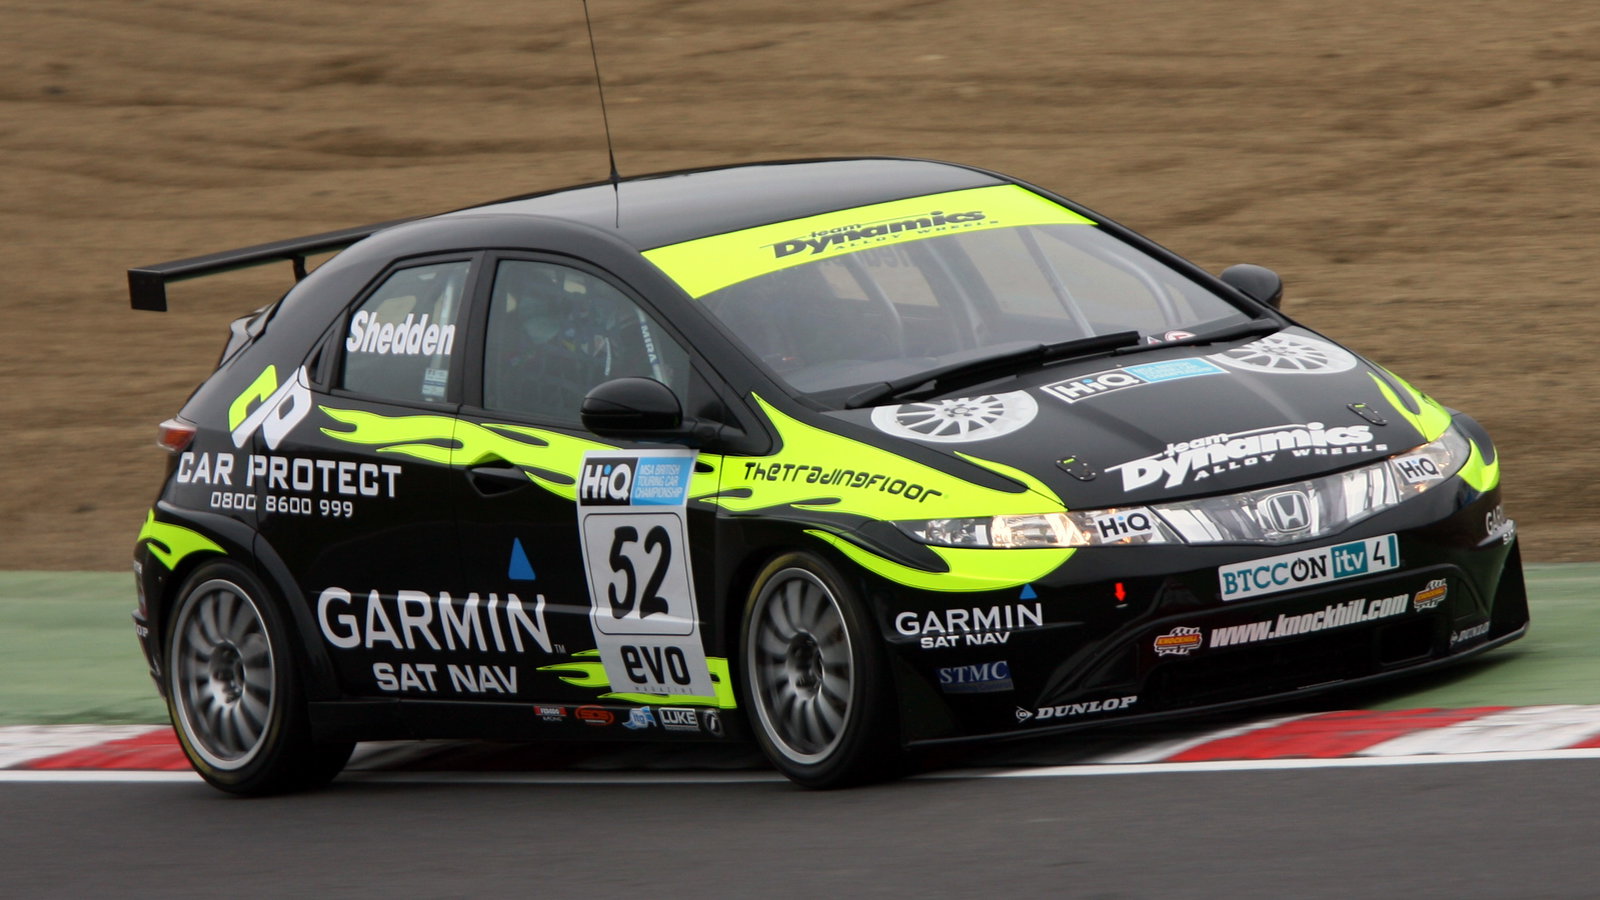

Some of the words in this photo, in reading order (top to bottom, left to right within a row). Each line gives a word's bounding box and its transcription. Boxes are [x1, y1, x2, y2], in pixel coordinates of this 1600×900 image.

[773, 210, 987, 258] Dynamics
[809, 223, 862, 239] team
[835, 235, 902, 250] ALLOY
[346, 309, 456, 356] Shedden
[1054, 373, 1140, 398] HiQ
[1121, 422, 1374, 492] Dynamics
[1164, 433, 1229, 457] team
[176, 451, 235, 486] CAR
[246, 454, 401, 498] PROTECT
[1193, 453, 1276, 481] ALLOY
[1291, 443, 1388, 457] WHEELS
[1398, 458, 1439, 479] HiQ
[581, 463, 632, 500] HiQ
[210, 491, 257, 511] 0800
[265, 496, 313, 515] 8600
[320, 500, 354, 518] 999
[1099, 513, 1151, 539] HiQ
[609, 526, 672, 619] 52
[1333, 550, 1366, 574] itv
[1373, 543, 1387, 567] 4
[317, 586, 554, 654] GARMIN
[895, 602, 1044, 636] GARMIN
[1209, 593, 1410, 648] www.knockhill.com
[921, 635, 960, 649] SAT
[965, 631, 1011, 646] NAV
[372, 662, 438, 692] SAT
[447, 664, 518, 694] NAV
[620, 645, 691, 685] evo
[940, 660, 1008, 684] STMC
[660, 710, 696, 725] LUKE
[1034, 695, 1138, 719] DUNLOP
